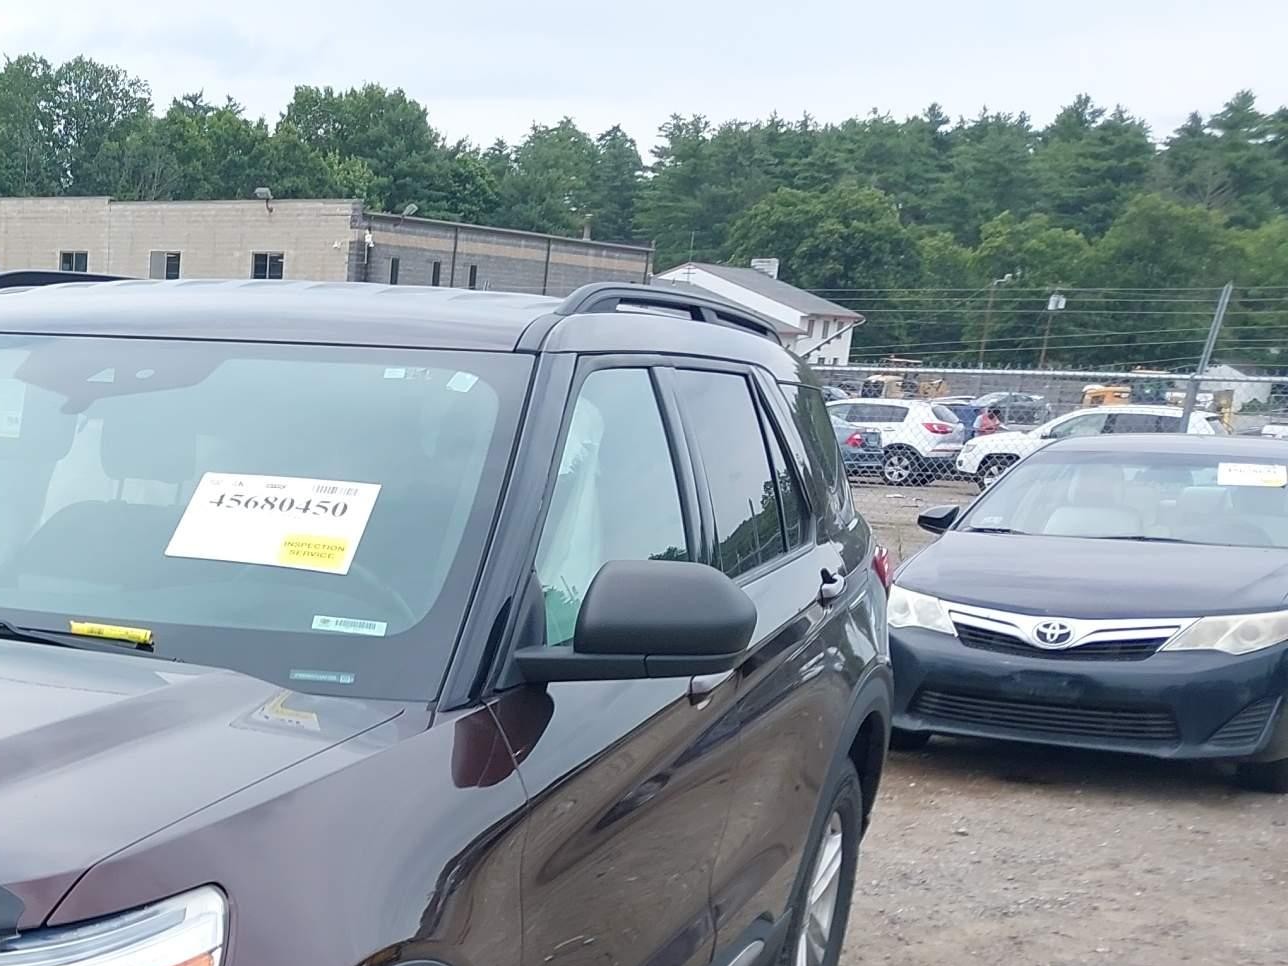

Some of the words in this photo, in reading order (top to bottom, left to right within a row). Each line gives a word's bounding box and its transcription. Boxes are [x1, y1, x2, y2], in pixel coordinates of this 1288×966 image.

[208, 492, 350, 518] 45680450
[283, 540, 346, 552] INSPECTION
[289, 549, 336, 560] SERVICE
